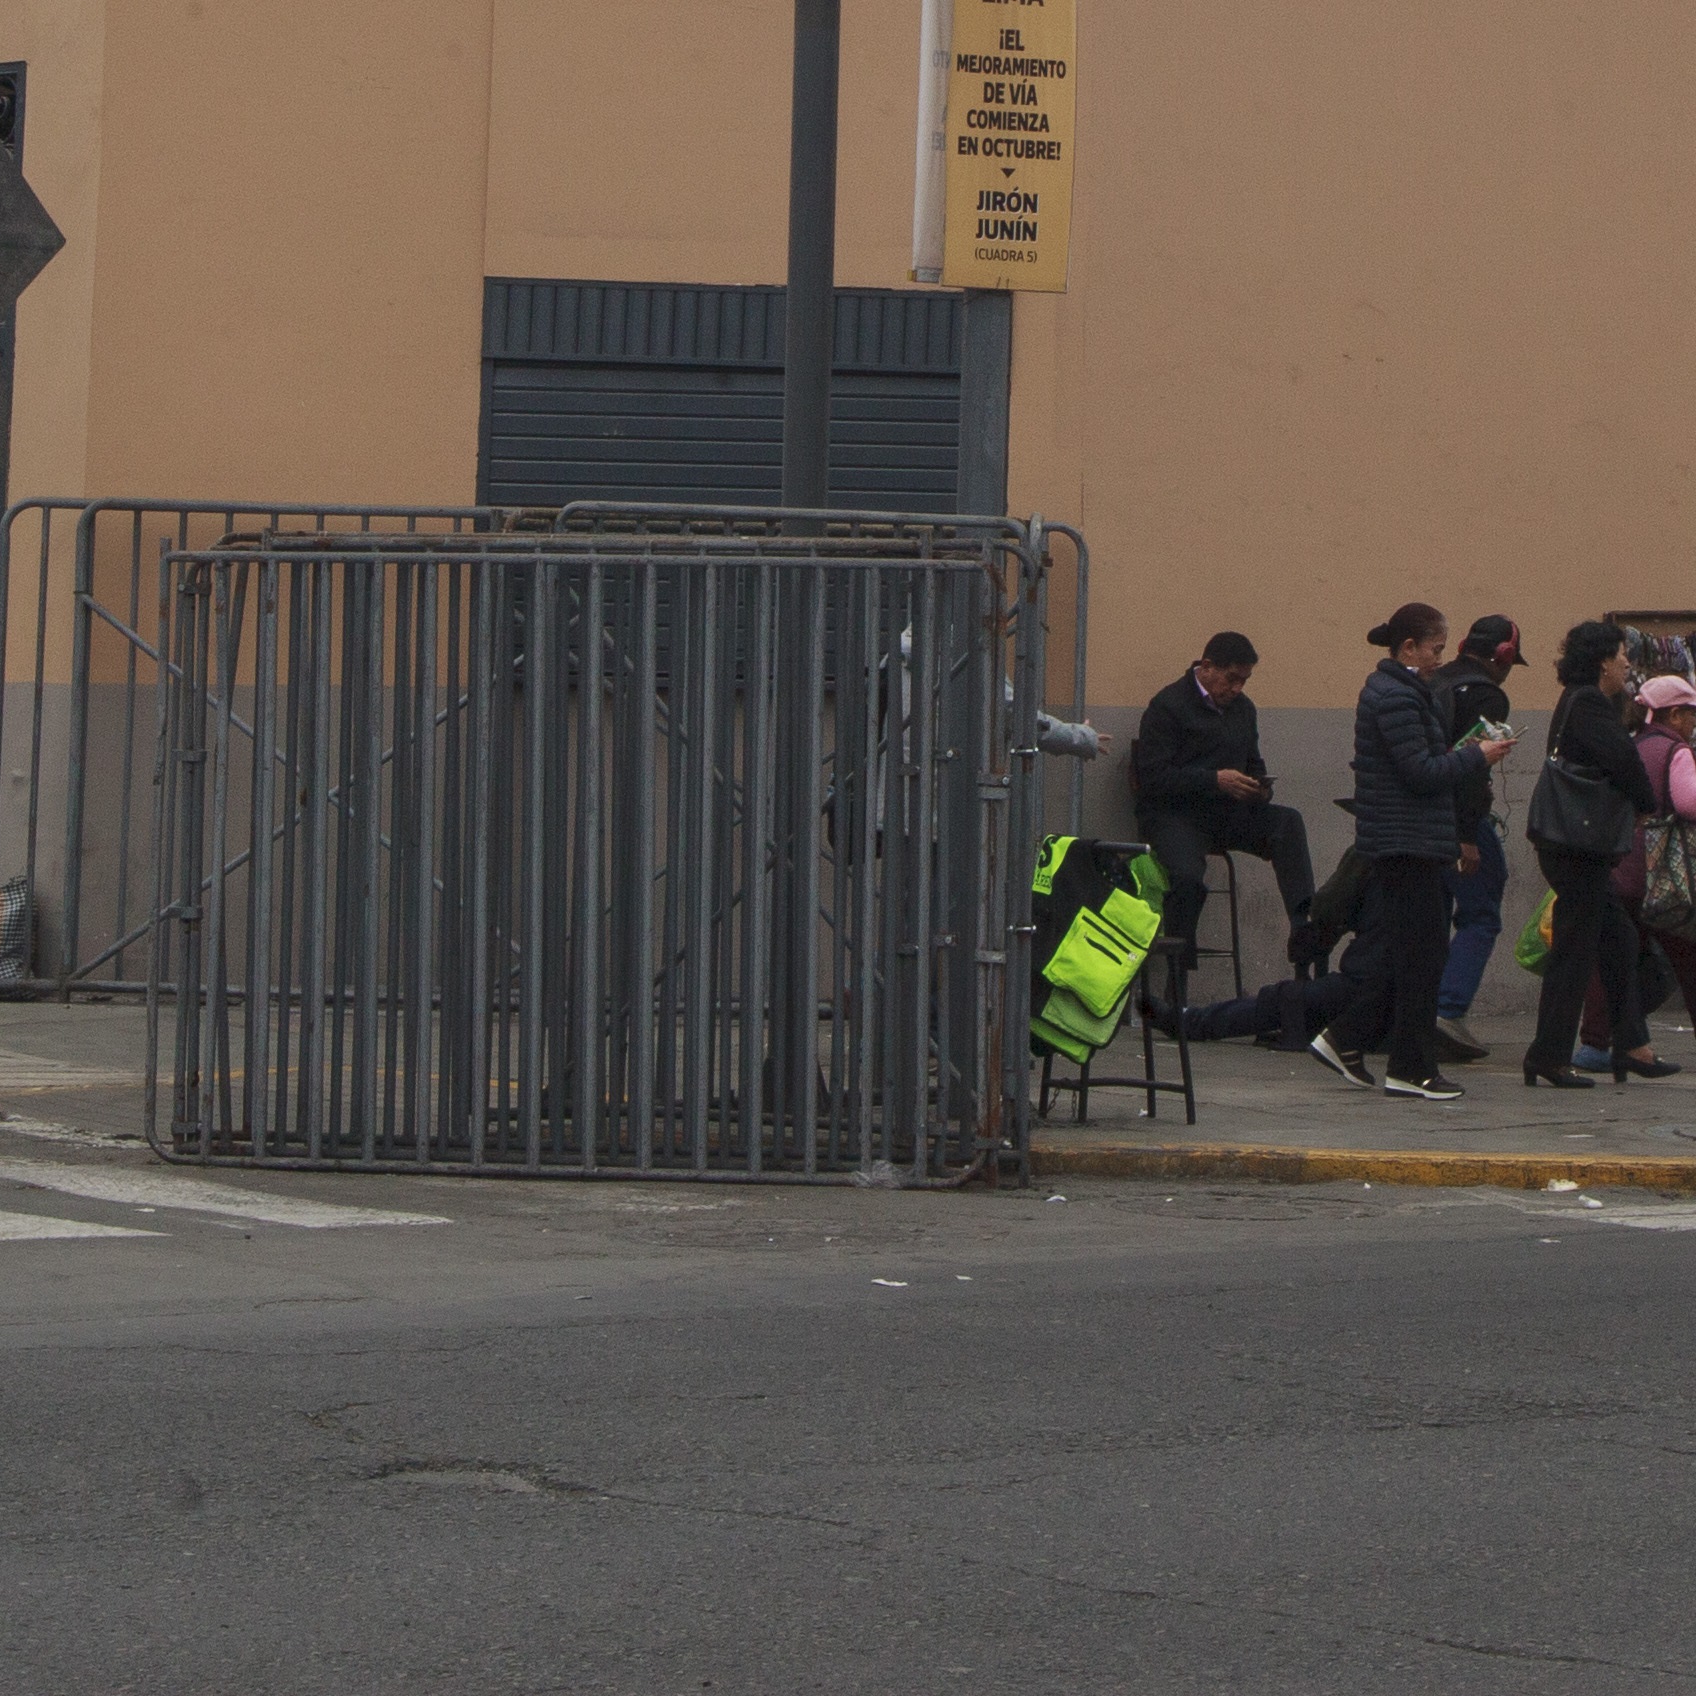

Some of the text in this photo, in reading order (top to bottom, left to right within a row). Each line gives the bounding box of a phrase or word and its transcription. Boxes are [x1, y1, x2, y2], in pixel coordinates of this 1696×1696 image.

[957, 54, 1066, 80] MEJORAMIENTO
[984, 79, 1037, 106] DE VÍA
[967, 109, 1049, 132] COMIENZA
[958, 136, 978, 155] EN
[982, 138, 1060, 160] OCTUBRE!
[977, 187, 1037, 213] JIRÓN
[976, 216, 1037, 241] JUNÍN
[975, 248, 1037, 263] (CUADRA 5)
